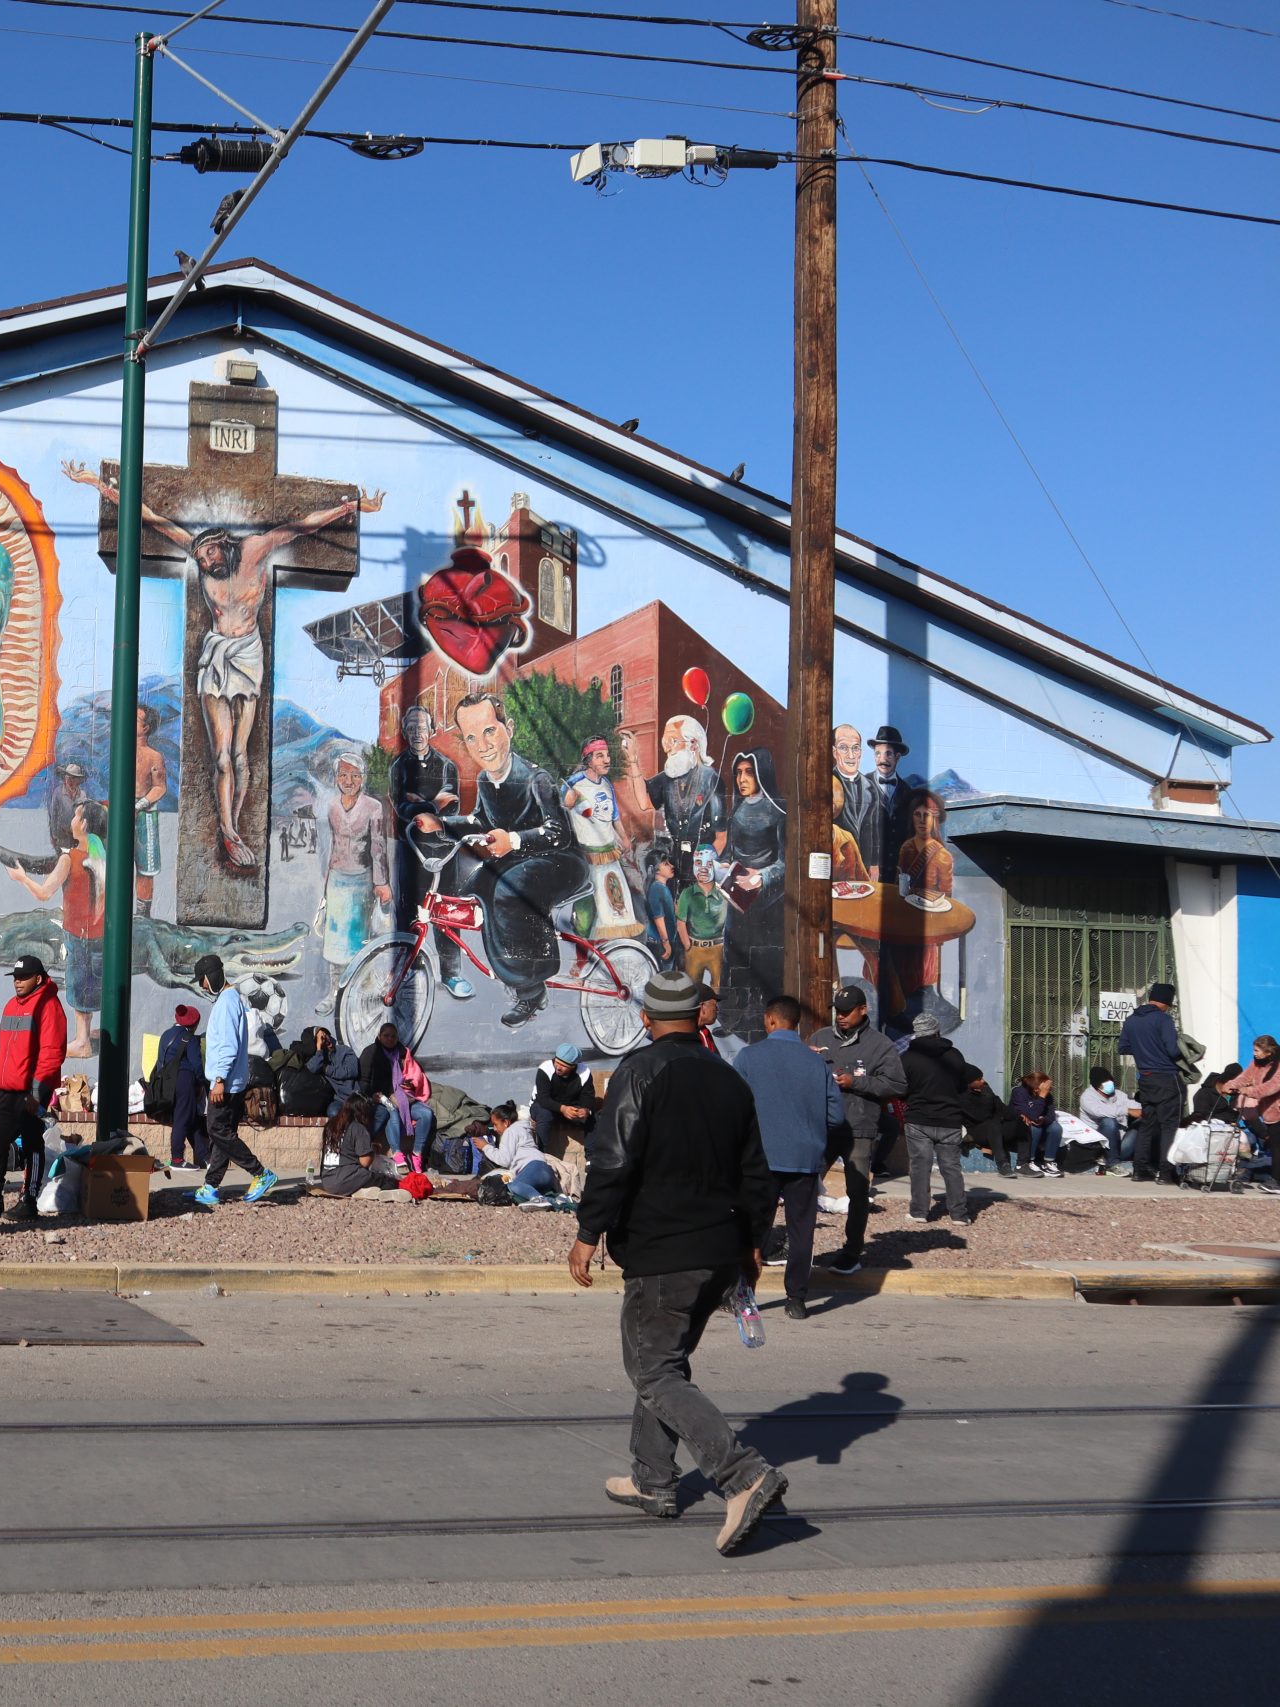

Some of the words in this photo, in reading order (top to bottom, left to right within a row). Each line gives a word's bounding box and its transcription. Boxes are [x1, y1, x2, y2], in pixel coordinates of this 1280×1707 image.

[214, 426, 248, 450] INRI
[1101, 1000, 1134, 1010] SALIDA
[1107, 1009, 1130, 1020] EXIT
